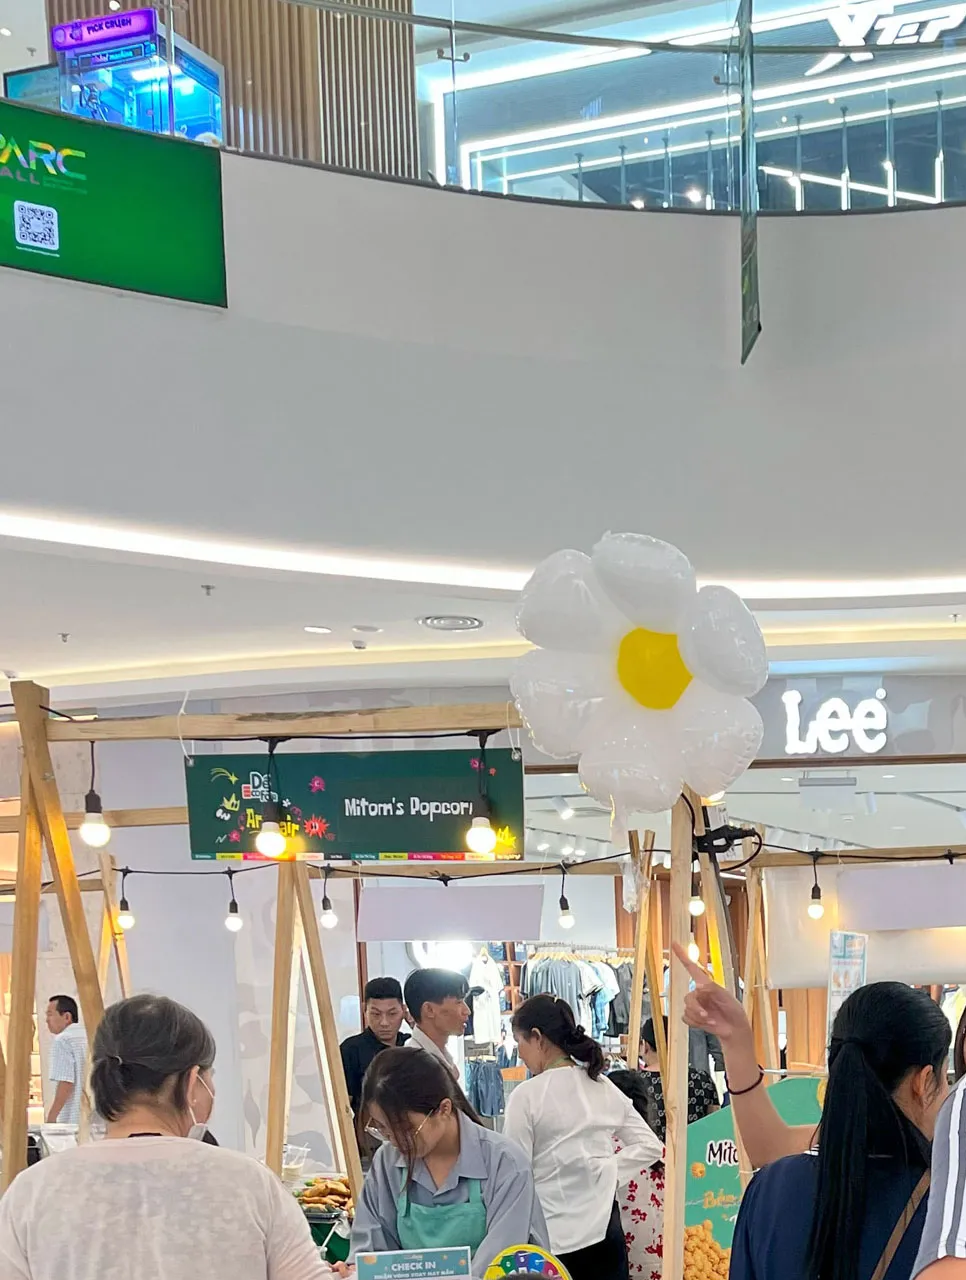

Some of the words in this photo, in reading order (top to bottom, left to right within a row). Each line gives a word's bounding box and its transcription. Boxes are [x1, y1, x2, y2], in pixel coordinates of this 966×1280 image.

[781, 689, 887, 755] Lee
[344, 797, 405, 817] Mitom's
[245, 808, 264, 829] Ar
[279, 814, 300, 838] air
[706, 1140, 740, 1166] Mito
[391, 1262, 424, 1272] CHECK
[424, 1261, 436, 1270] IN
